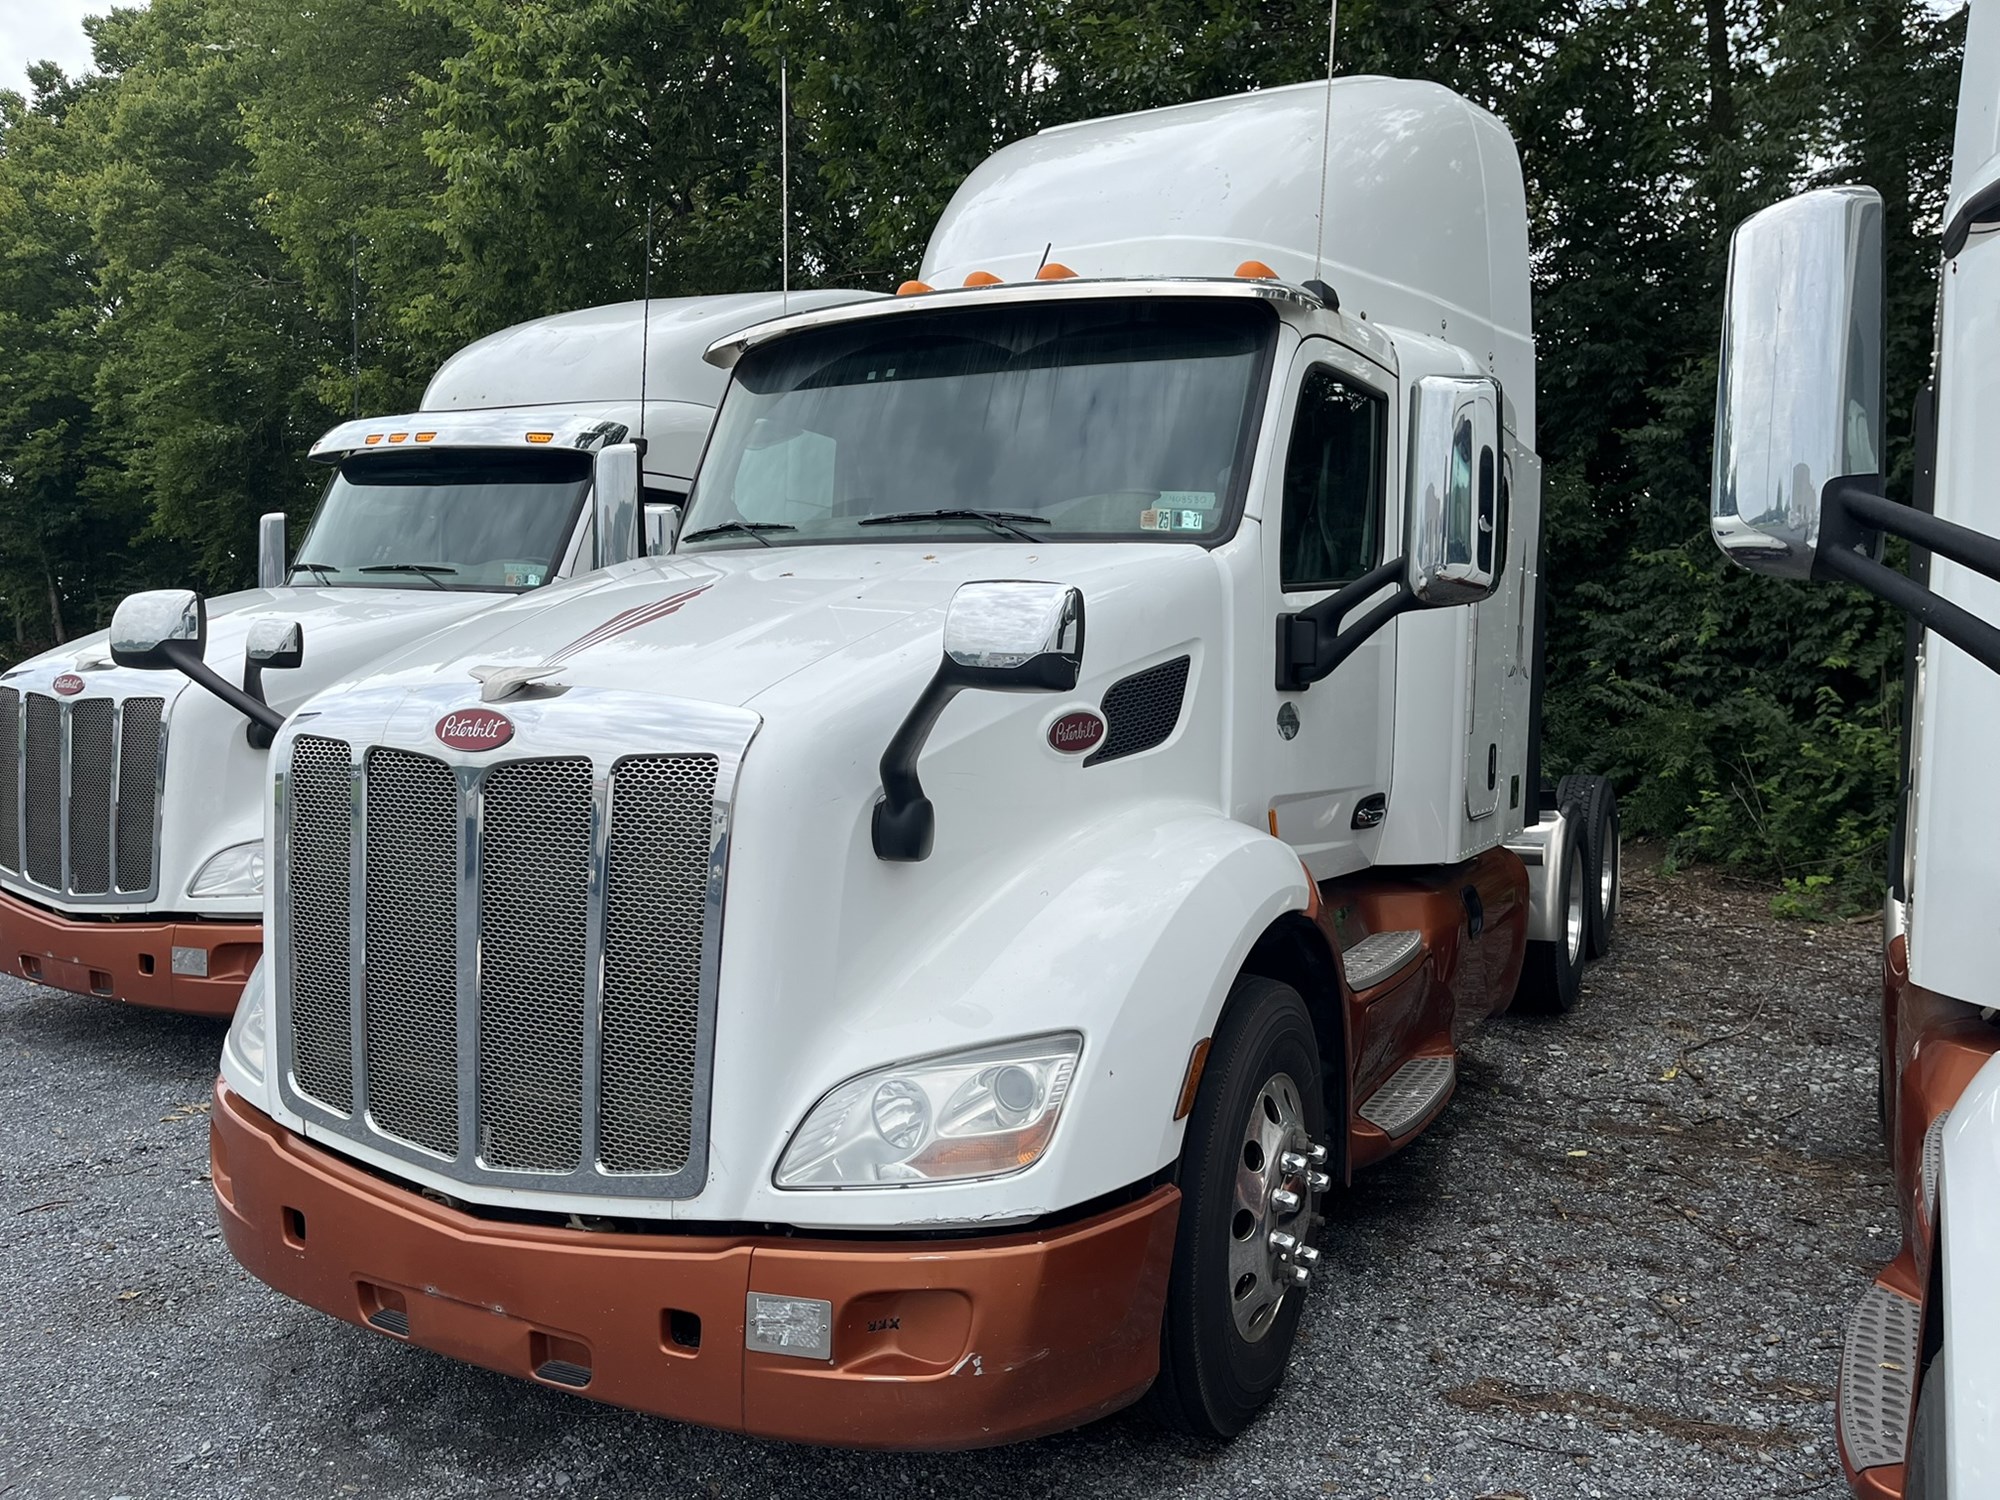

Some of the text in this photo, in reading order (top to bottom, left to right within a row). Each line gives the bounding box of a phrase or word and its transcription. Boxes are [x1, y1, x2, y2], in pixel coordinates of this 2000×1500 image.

[1158, 511, 1169, 529] 25
[441, 715, 507, 738] Peterbilt
[1056, 720, 1100, 744] Peterbilt
